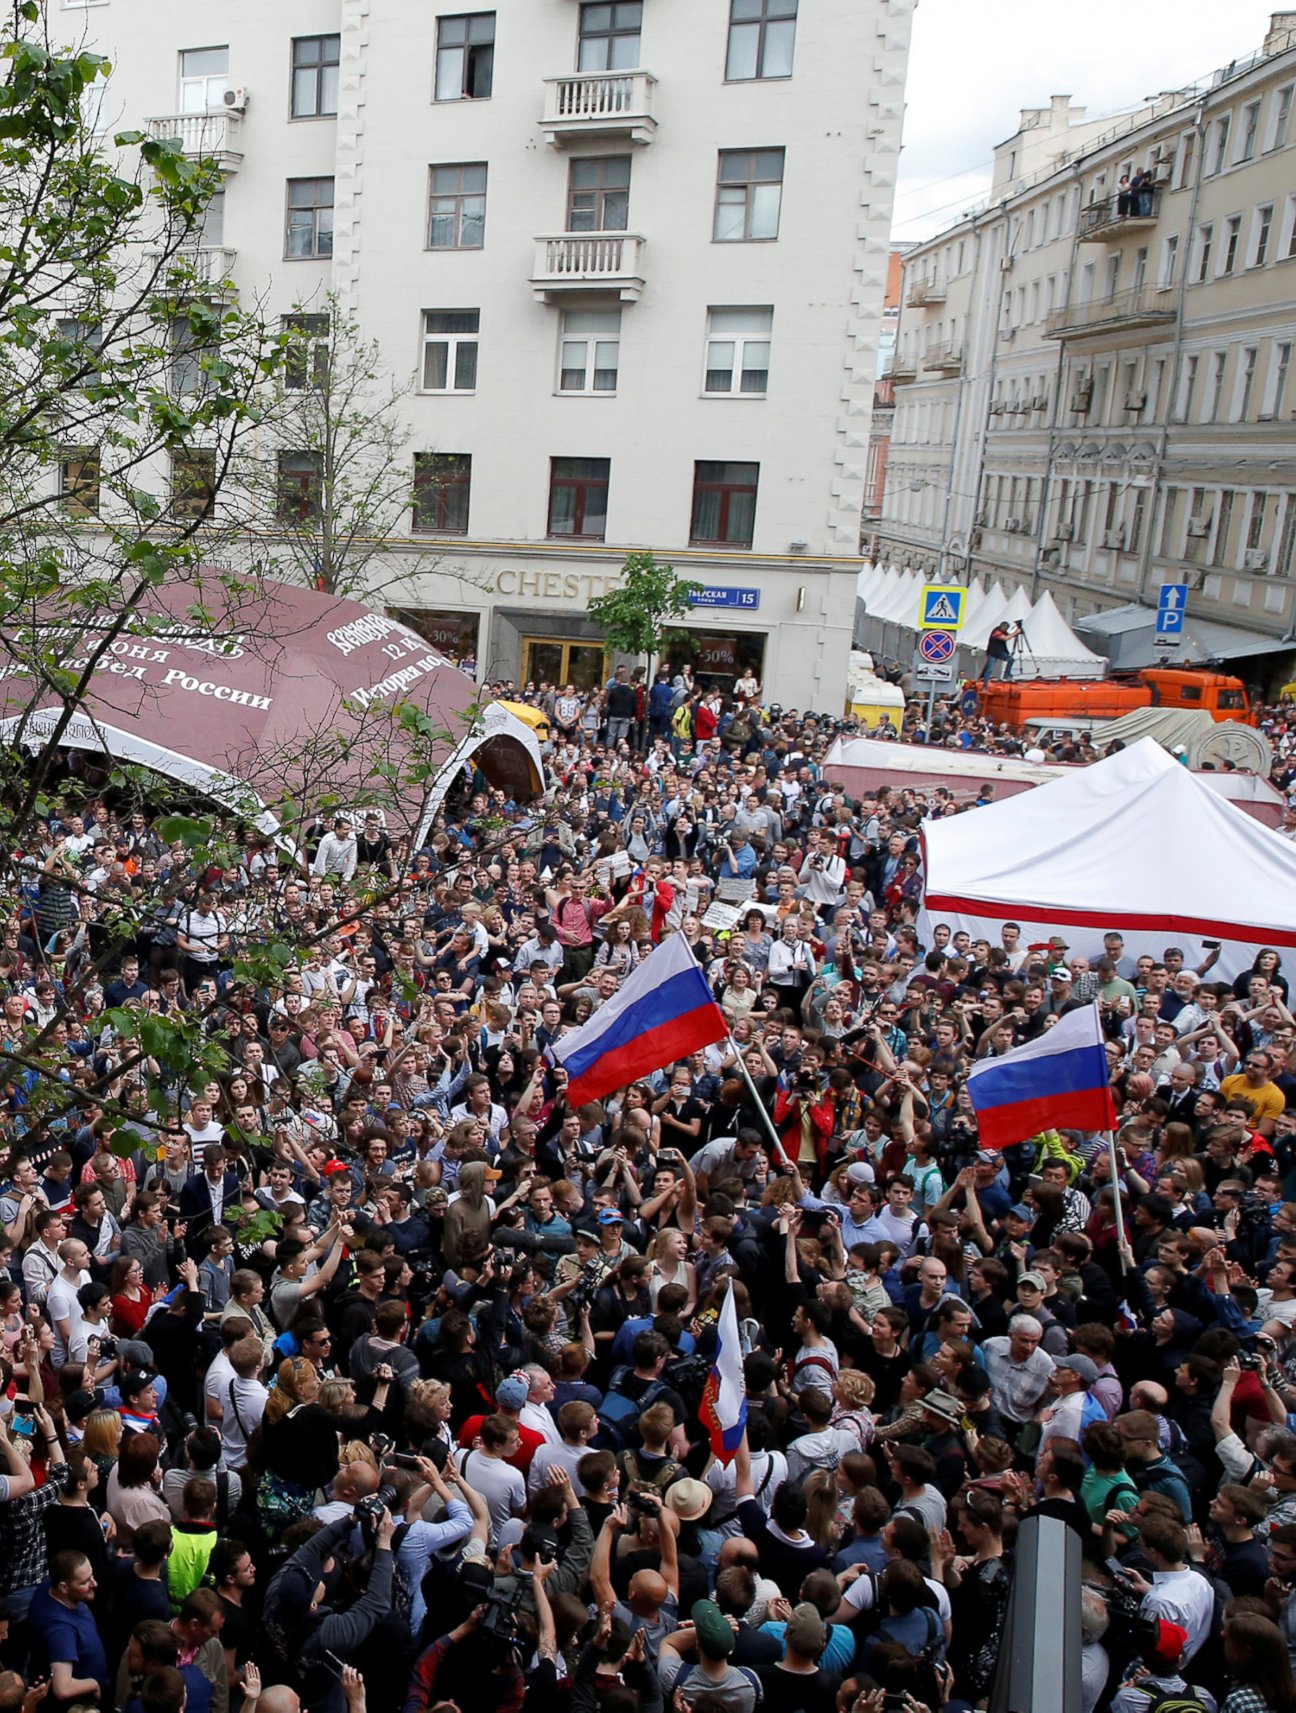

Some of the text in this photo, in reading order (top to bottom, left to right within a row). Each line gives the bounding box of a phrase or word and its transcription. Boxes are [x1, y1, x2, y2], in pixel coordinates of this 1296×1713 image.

[496, 570, 630, 600] CHESTE
[741, 593, 755, 604] 15
[1162, 611, 1179, 630] P
[428, 630, 459, 644] -30%
[382, 644, 407, 660] 12
[163, 668, 273, 711] России
[350, 665, 423, 708] История
